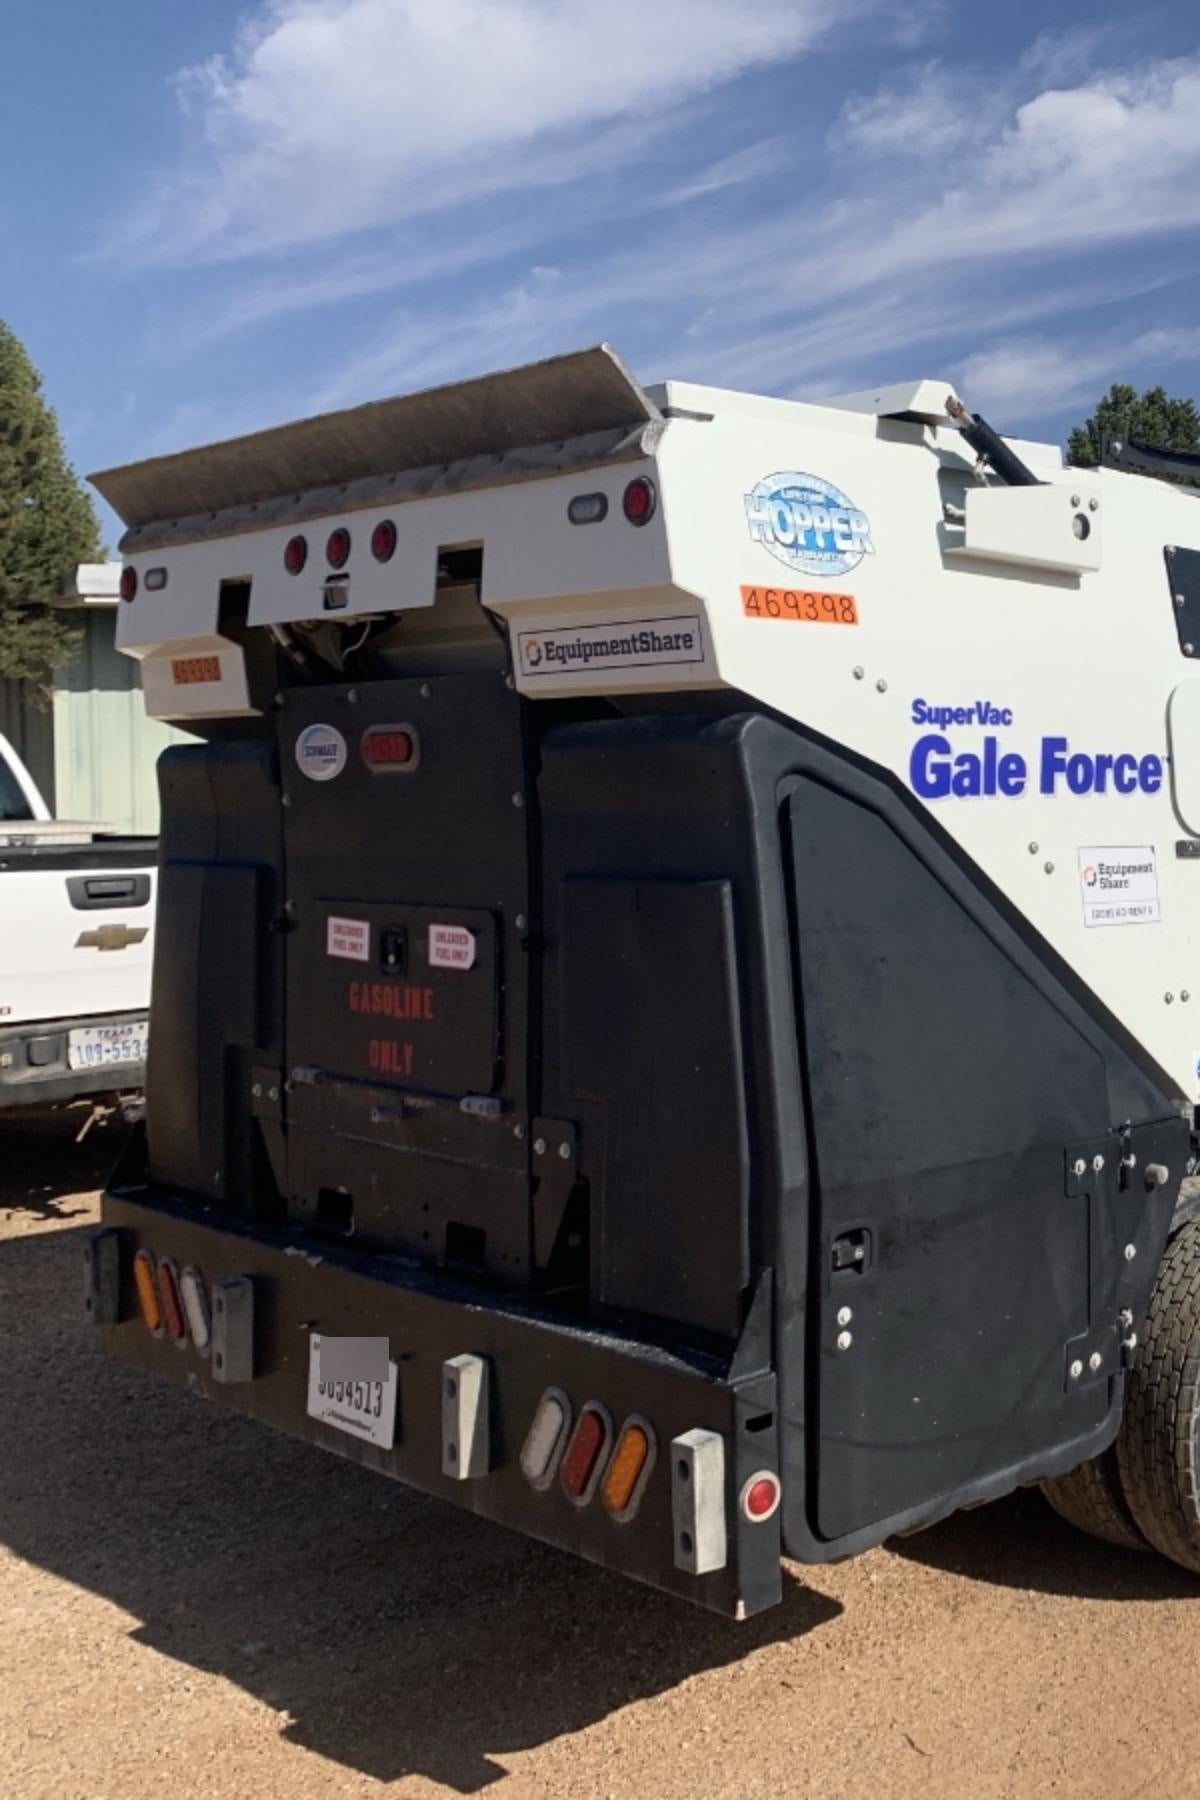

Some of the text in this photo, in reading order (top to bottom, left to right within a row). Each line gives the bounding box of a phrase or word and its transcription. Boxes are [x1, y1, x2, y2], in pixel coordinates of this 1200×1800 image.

[744, 493, 875, 554] HOPPER
[745, 589, 856, 623] 469398
[544, 631, 693, 664] EquipmentShare
[911, 698, 1013, 730] SuperVac
[909, 734, 1163, 799] Gale Force
[1098, 862, 1153, 877] Equipment
[348, 981, 434, 1020] GASOLINE
[97, 1027, 133, 1038] TEXAS
[368, 1039, 414, 1074] ONLY
